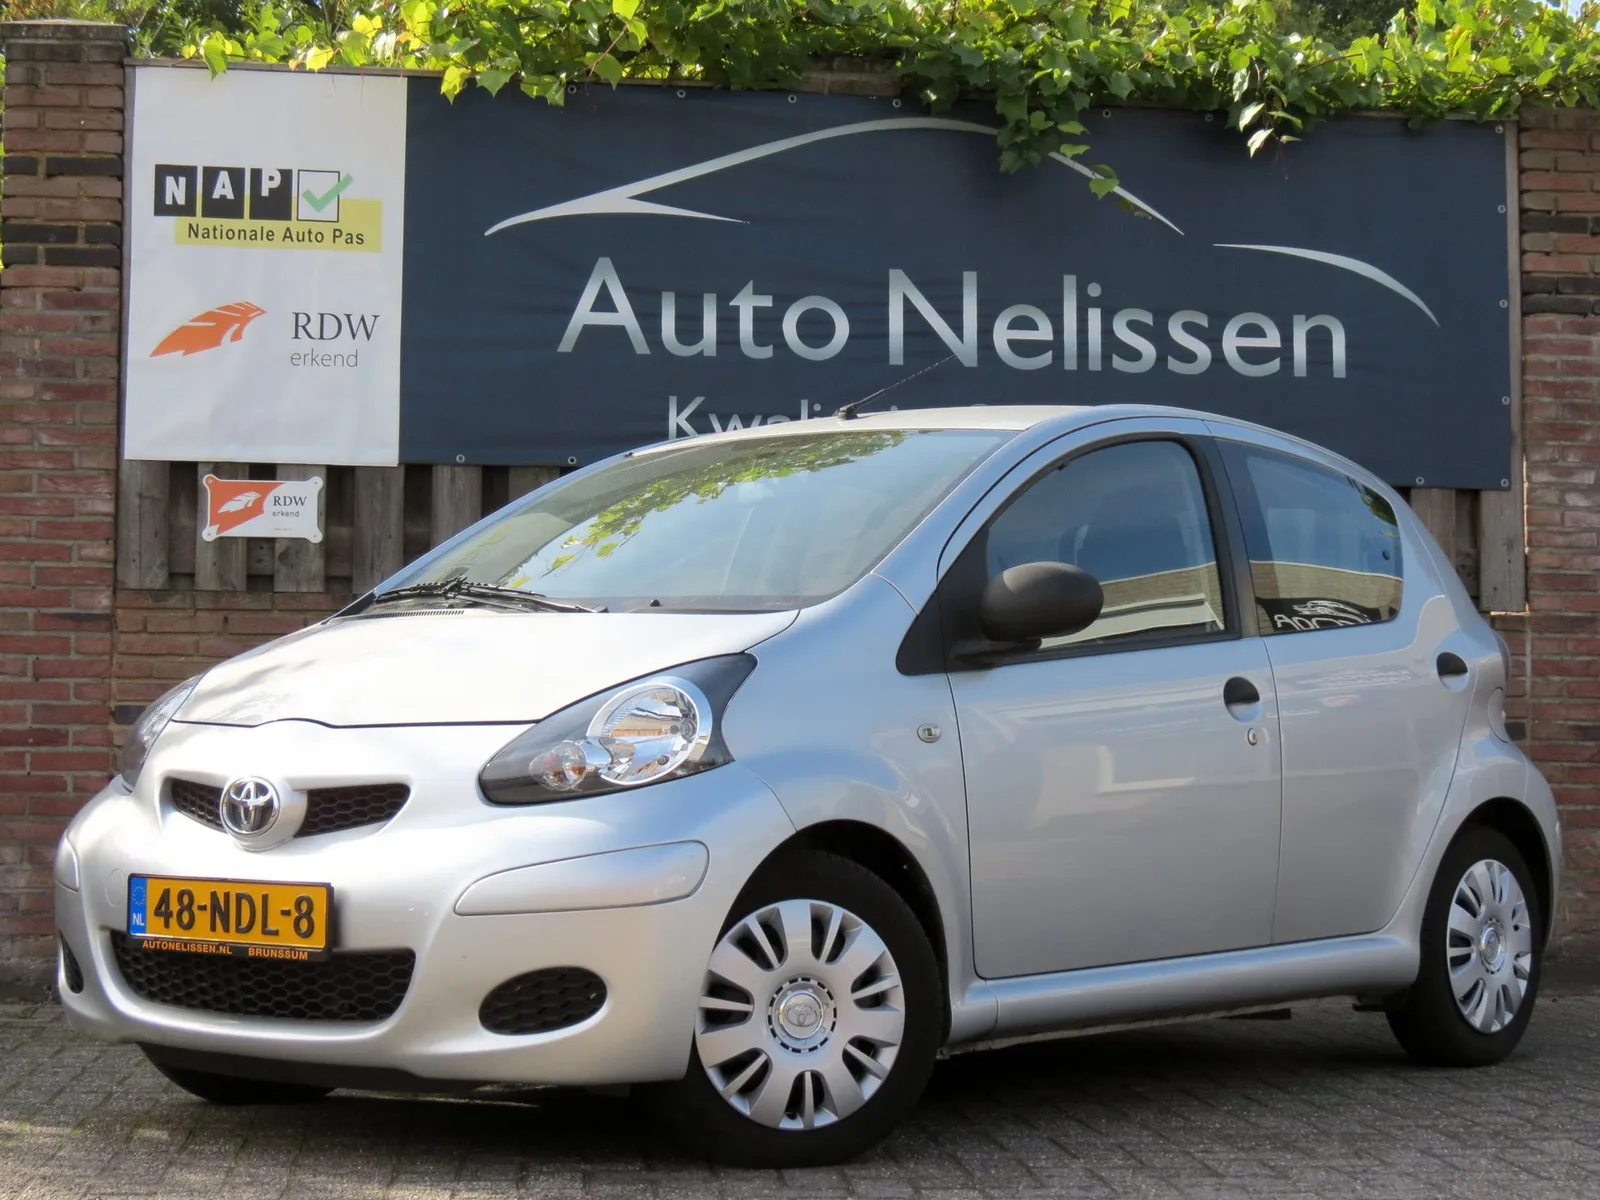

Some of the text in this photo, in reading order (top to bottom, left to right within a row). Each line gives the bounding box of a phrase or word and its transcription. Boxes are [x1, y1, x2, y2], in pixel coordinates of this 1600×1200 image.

[165, 168, 282, 205] NAP
[187, 222, 365, 245] Nationale Auto Pas
[291, 312, 380, 341] RDW
[556, 256, 1347, 379] Auto Nelissen
[290, 348, 358, 368] erkend
[272, 495, 308, 507] RDW
[272, 510, 300, 518] erkend
[132, 912, 145, 926] NL
[153, 887, 315, 939] 48-NDL-8
[142, 940, 308, 960] AUTONELISSEN.NL BRUNSSUM
